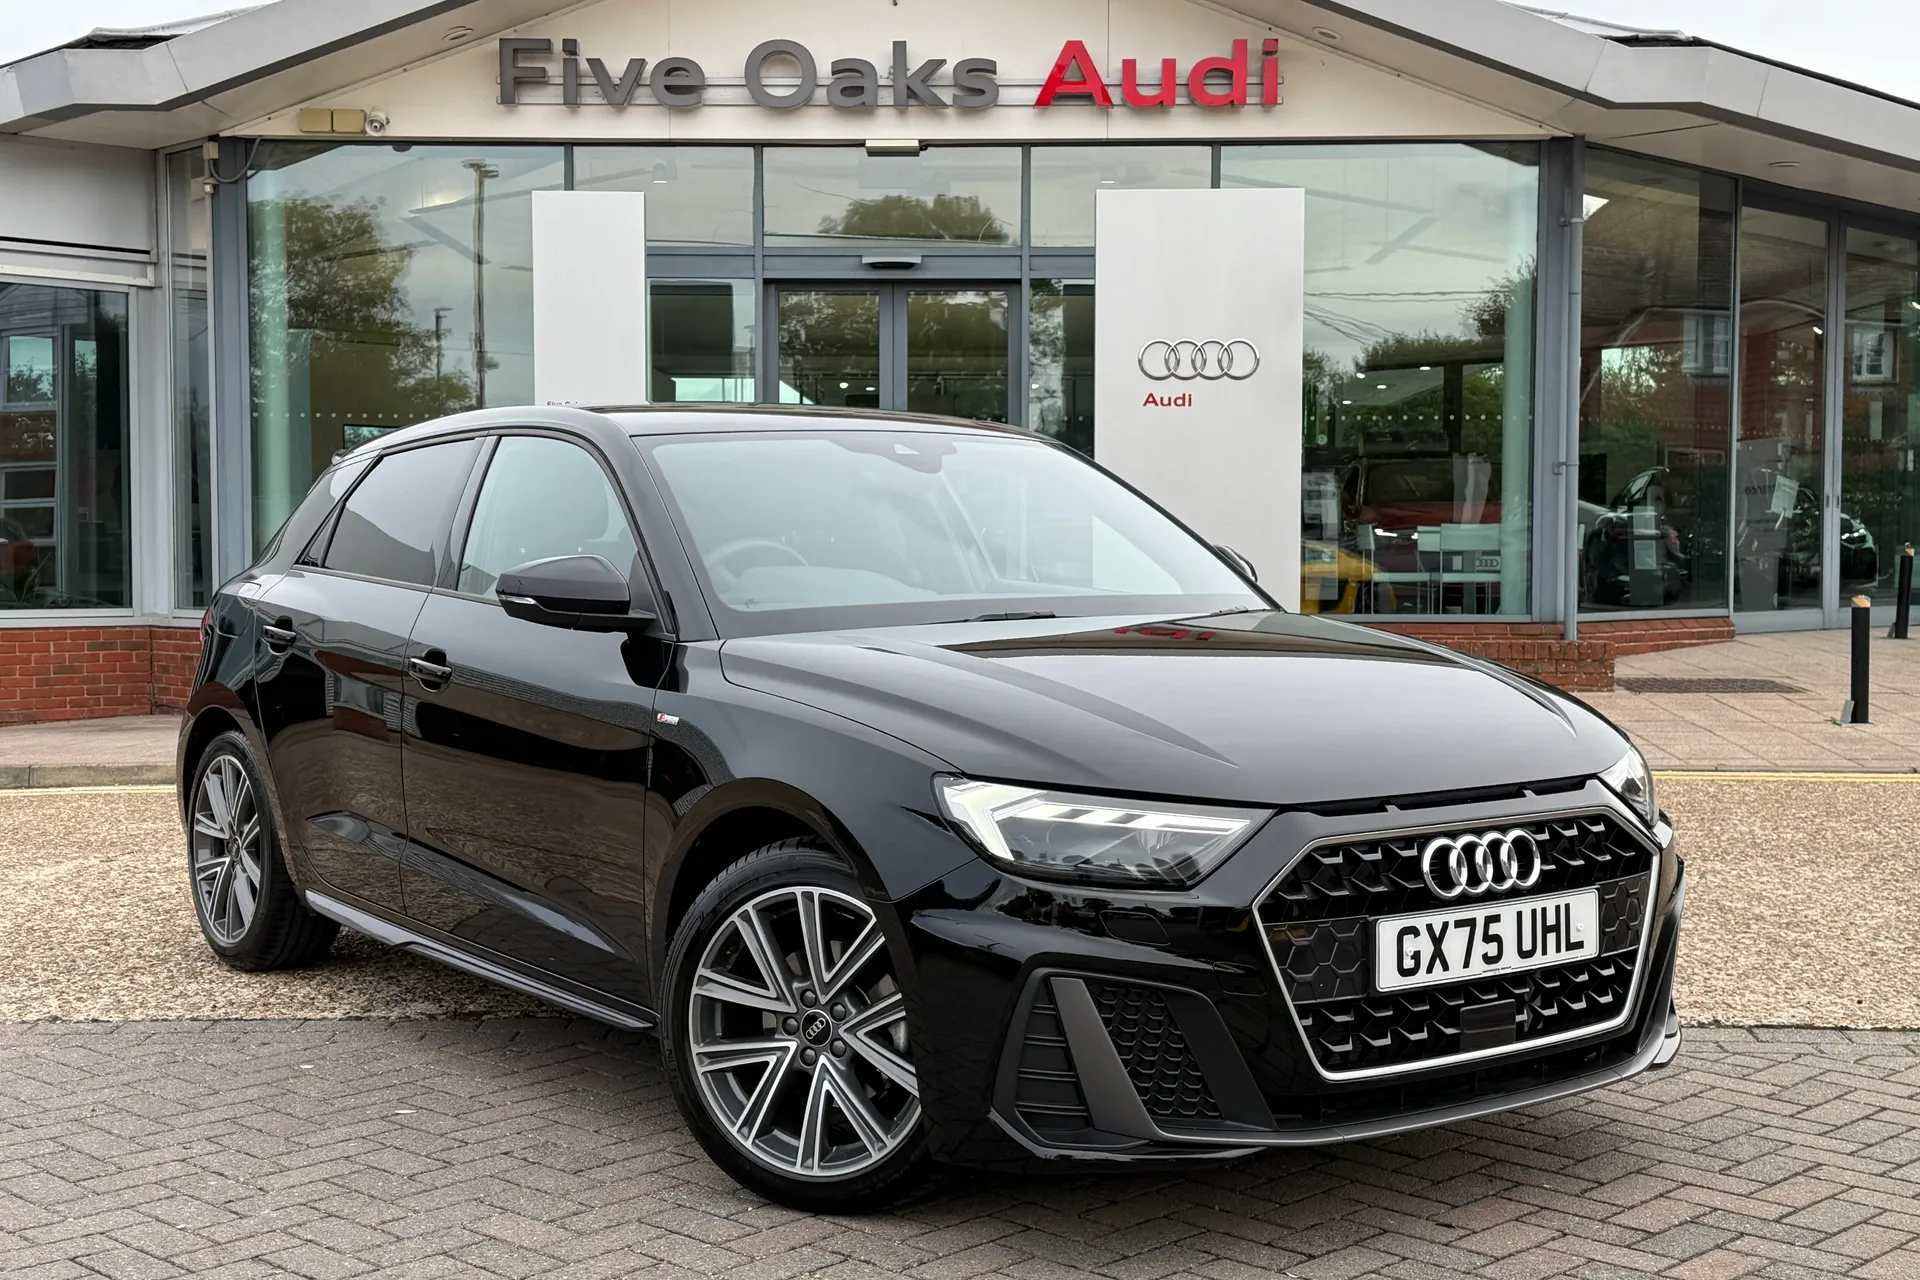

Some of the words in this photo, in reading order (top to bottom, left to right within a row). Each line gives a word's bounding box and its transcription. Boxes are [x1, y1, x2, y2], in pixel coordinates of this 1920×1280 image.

[498, 38, 705, 108] Five
[744, 39, 999, 110] Oaks
[1033, 38, 1281, 109] Audi
[1143, 392, 1192, 407] Audi
[1396, 913, 1504, 978] GX75
[1516, 902, 1585, 960] UHL
